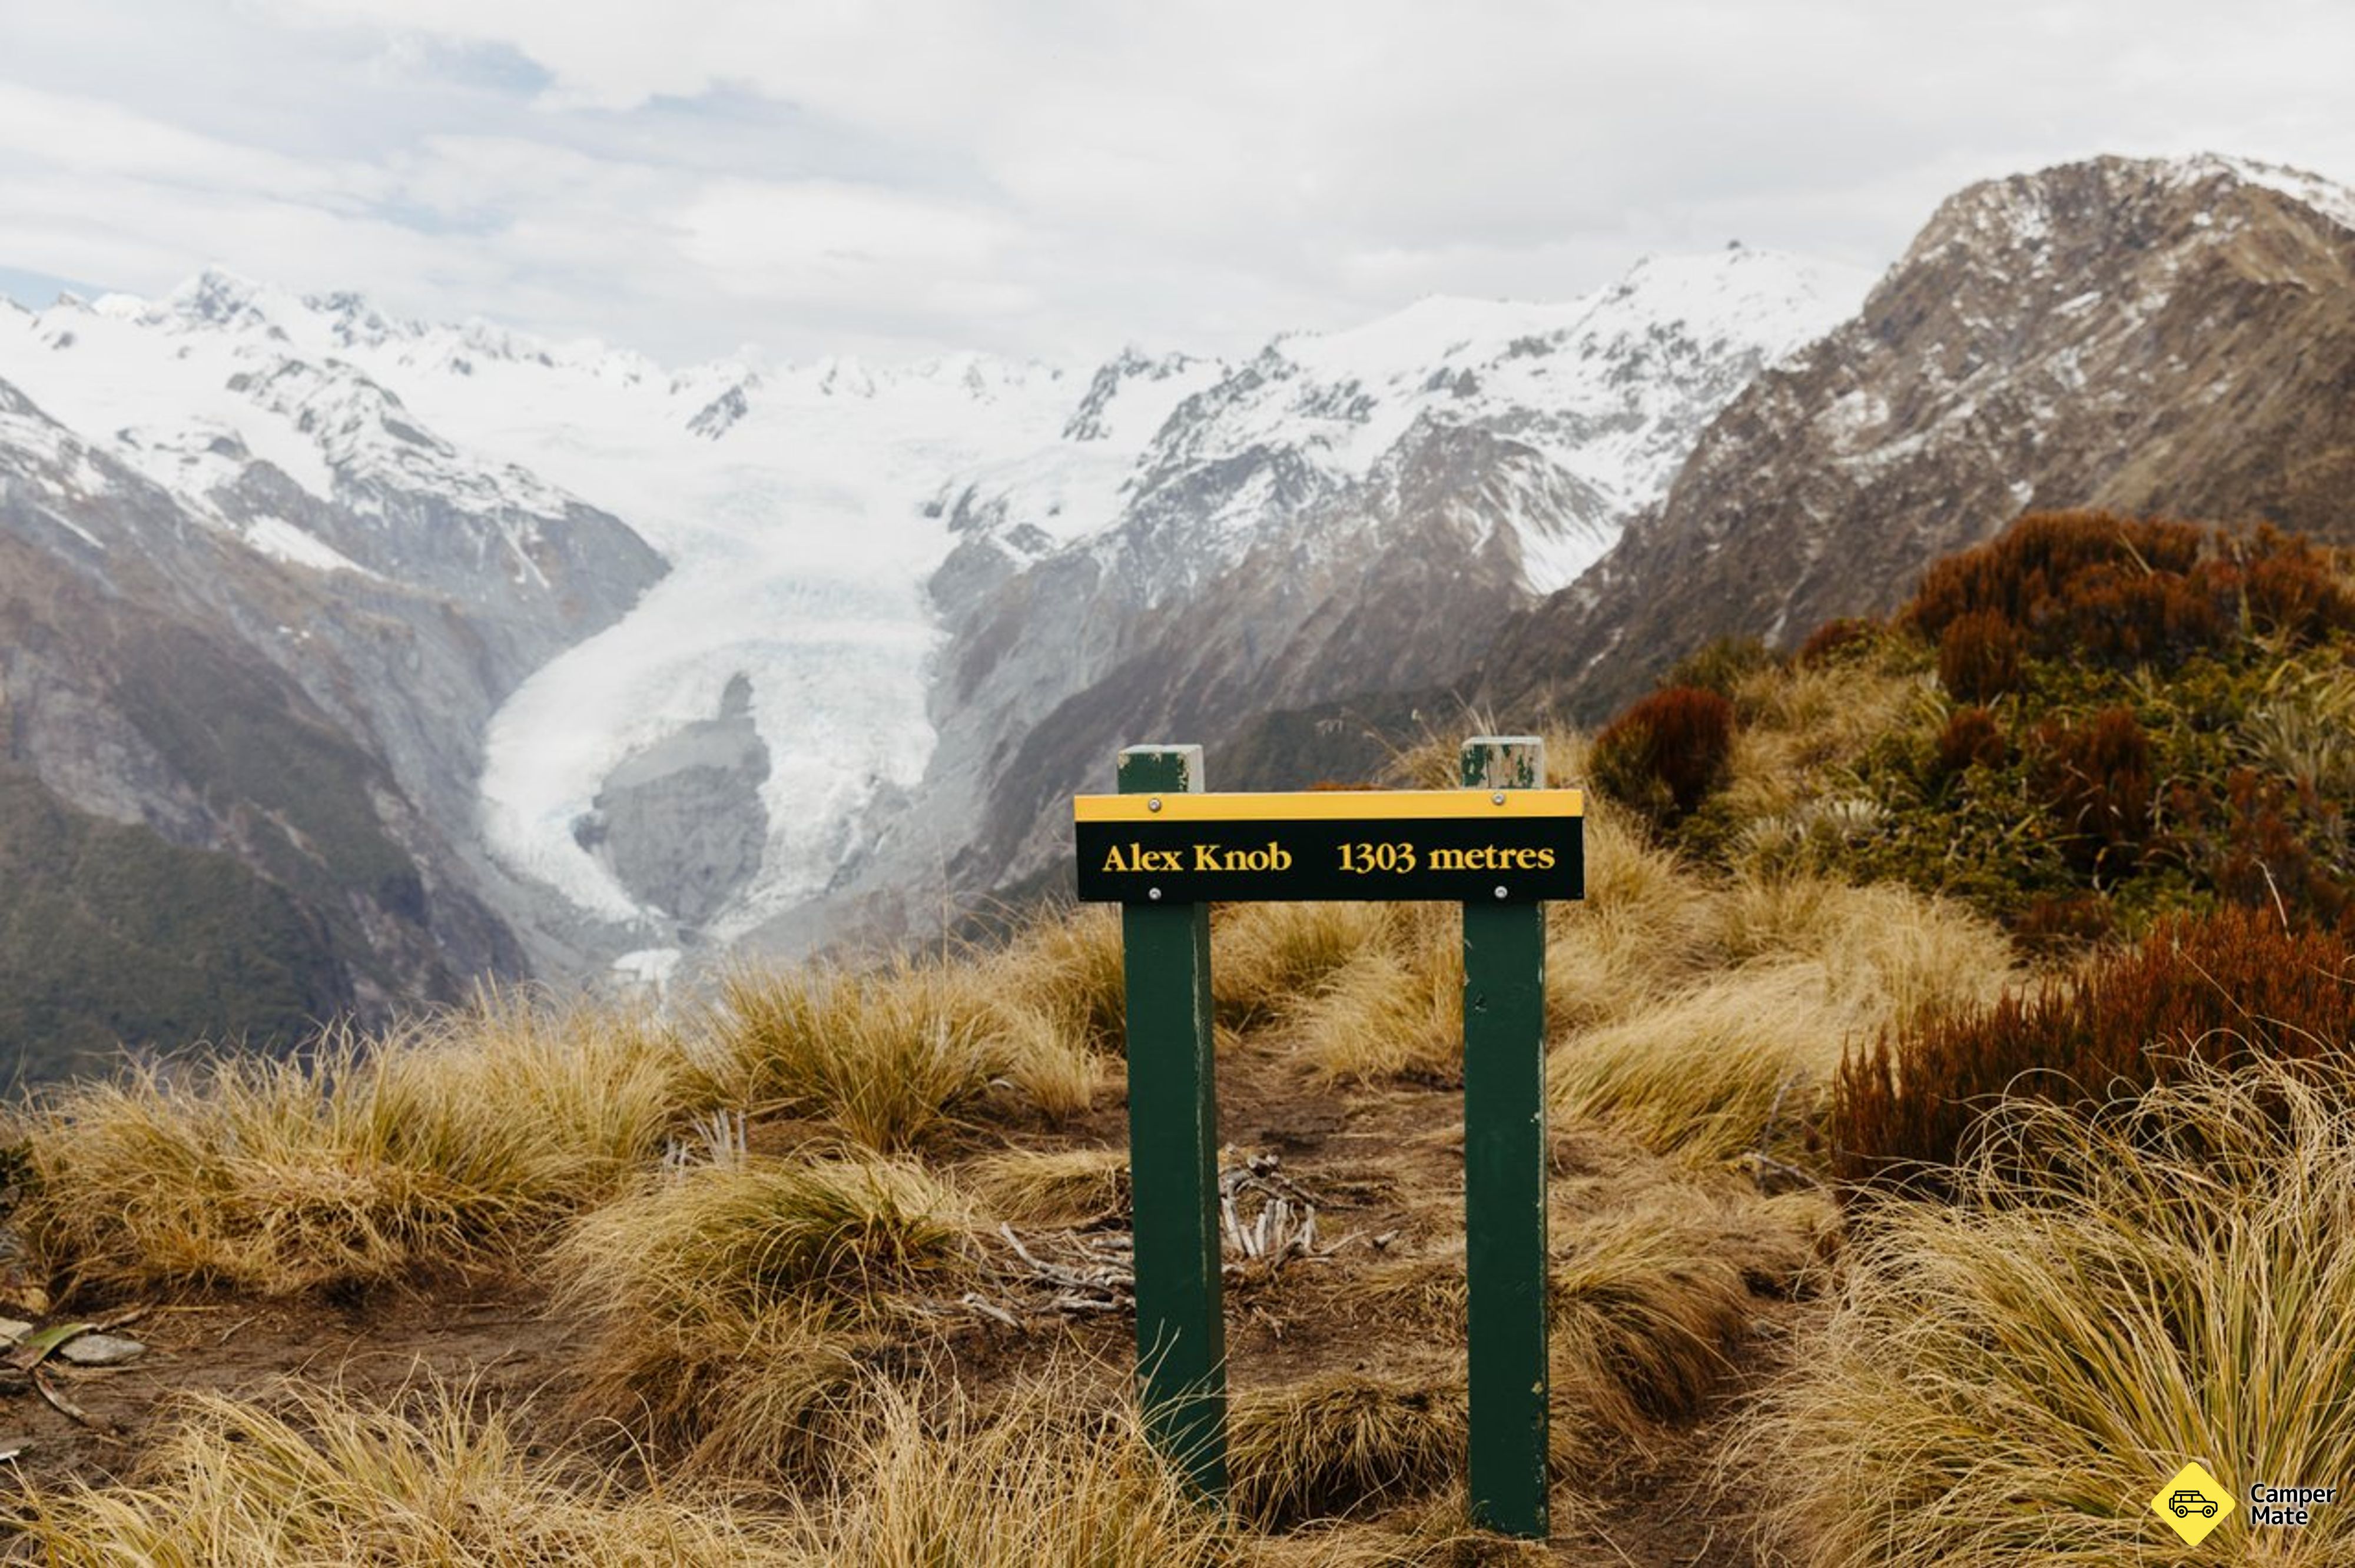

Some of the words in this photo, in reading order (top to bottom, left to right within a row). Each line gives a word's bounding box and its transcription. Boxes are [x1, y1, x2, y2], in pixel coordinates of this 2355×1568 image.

[1102, 842, 1183, 872] Alex
[1193, 841, 1293, 871] Knob
[1337, 842, 1416, 875] 1303
[1428, 845, 1555, 870] metres
